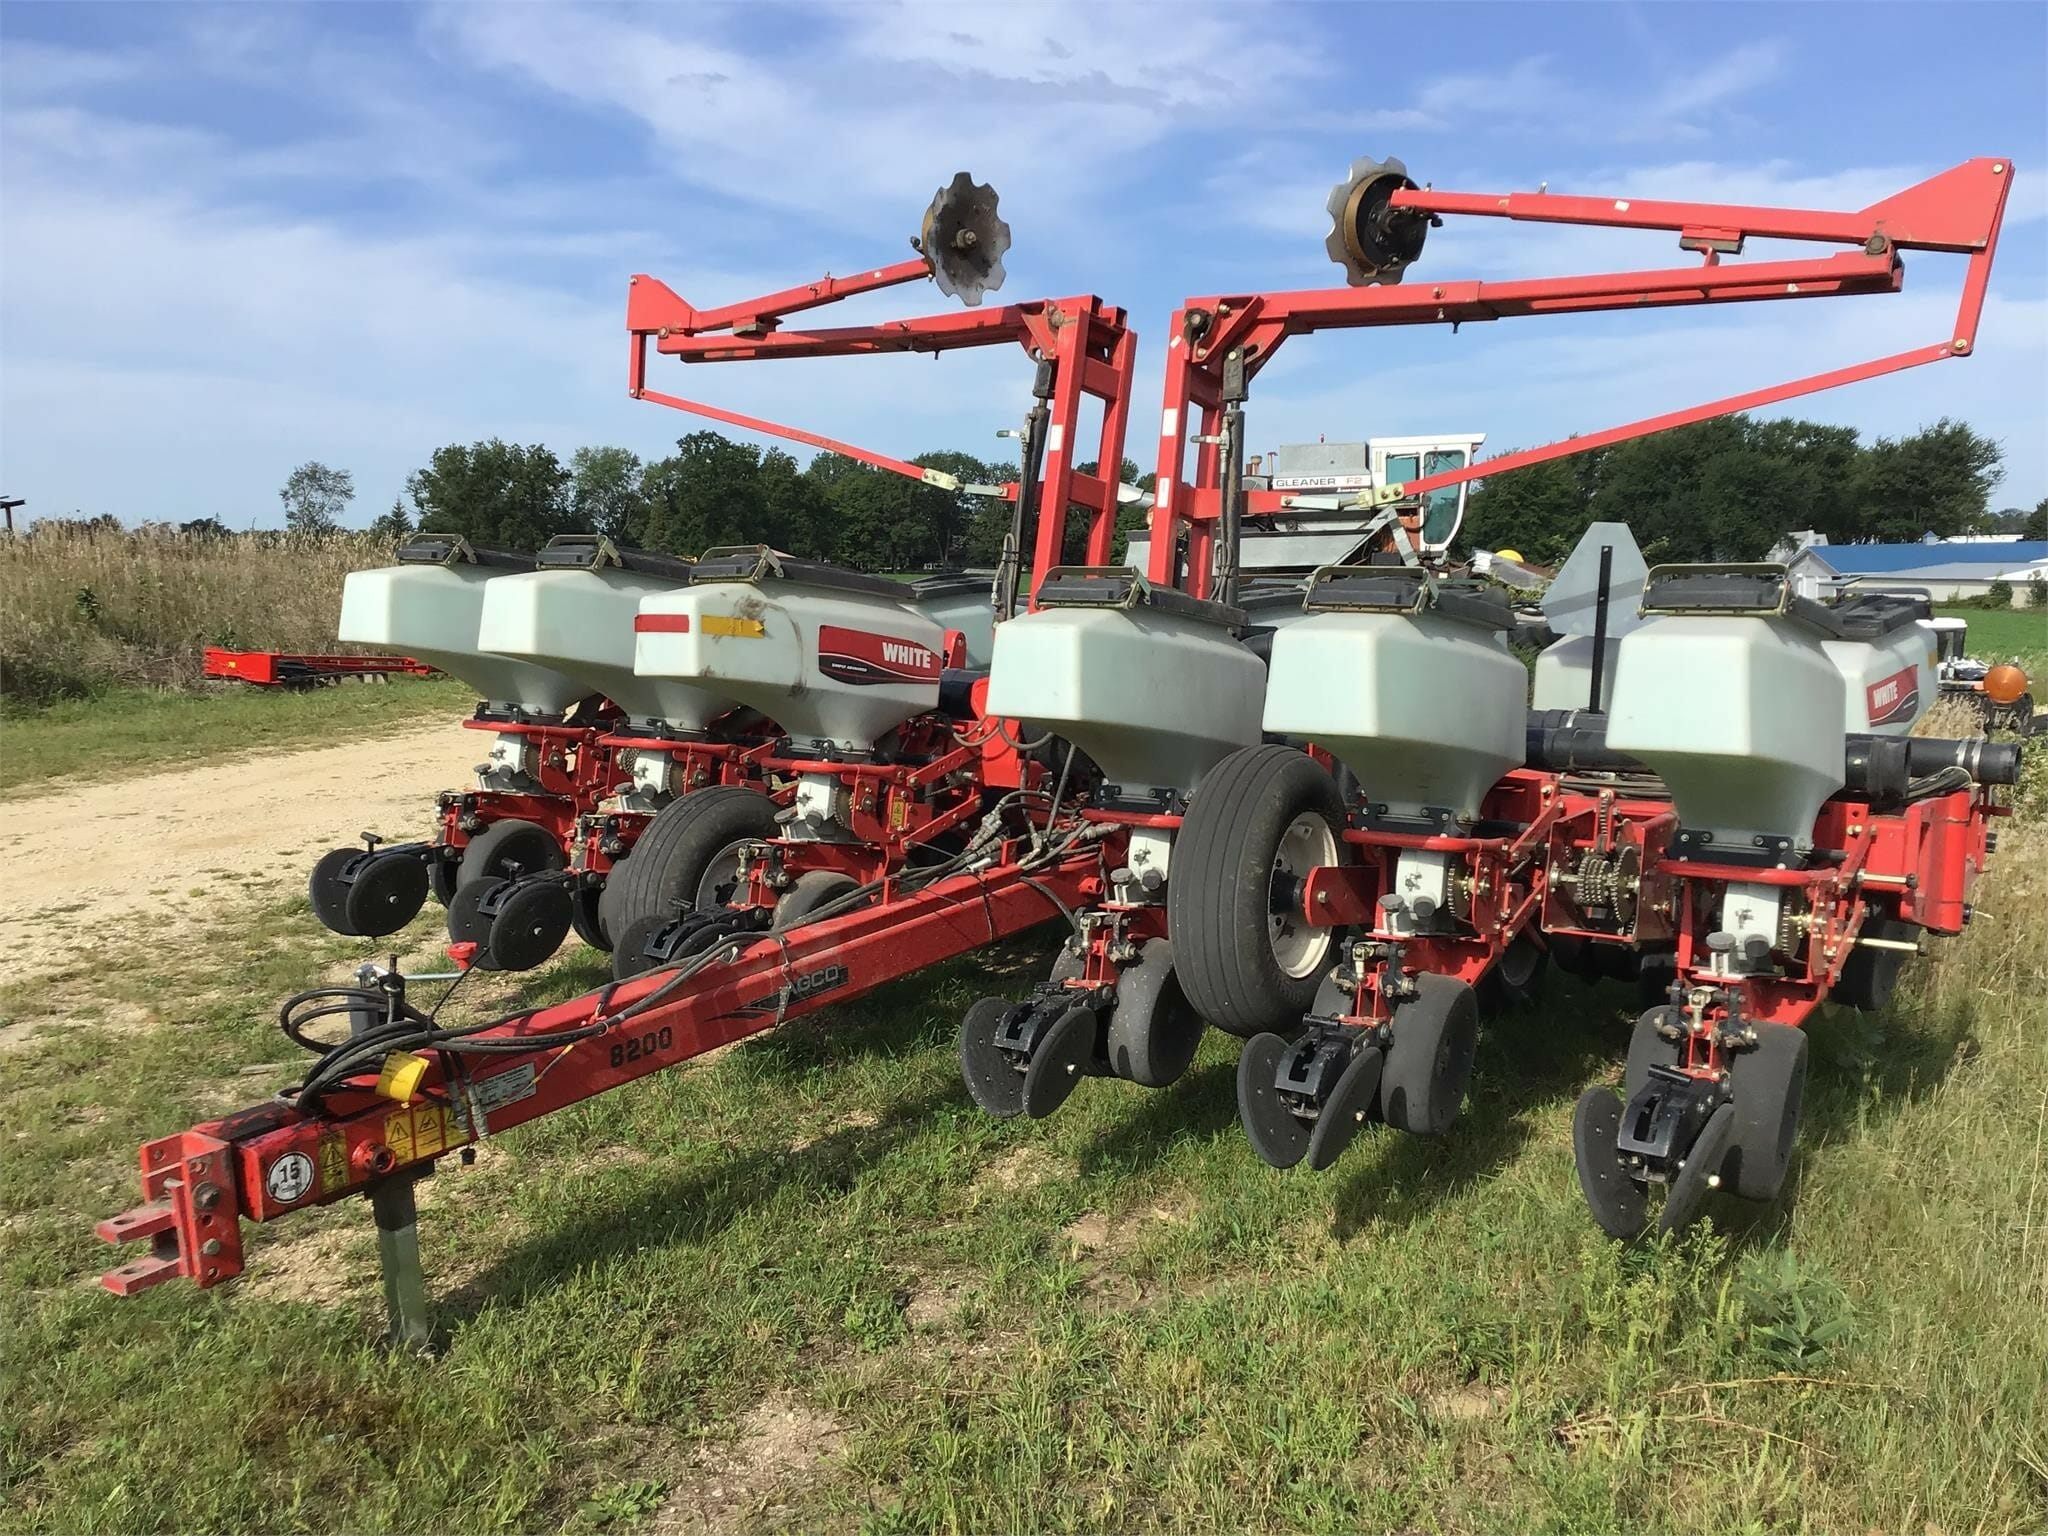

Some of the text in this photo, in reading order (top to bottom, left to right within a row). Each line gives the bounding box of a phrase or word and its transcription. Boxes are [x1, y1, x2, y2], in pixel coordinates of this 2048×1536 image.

[1276, 477, 1336, 487] GLEANER
[882, 641, 931, 669] WHITE
[1873, 680, 1898, 709] WHITE
[609, 1025, 673, 1068] 8200
[279, 1160, 301, 1184] 15
